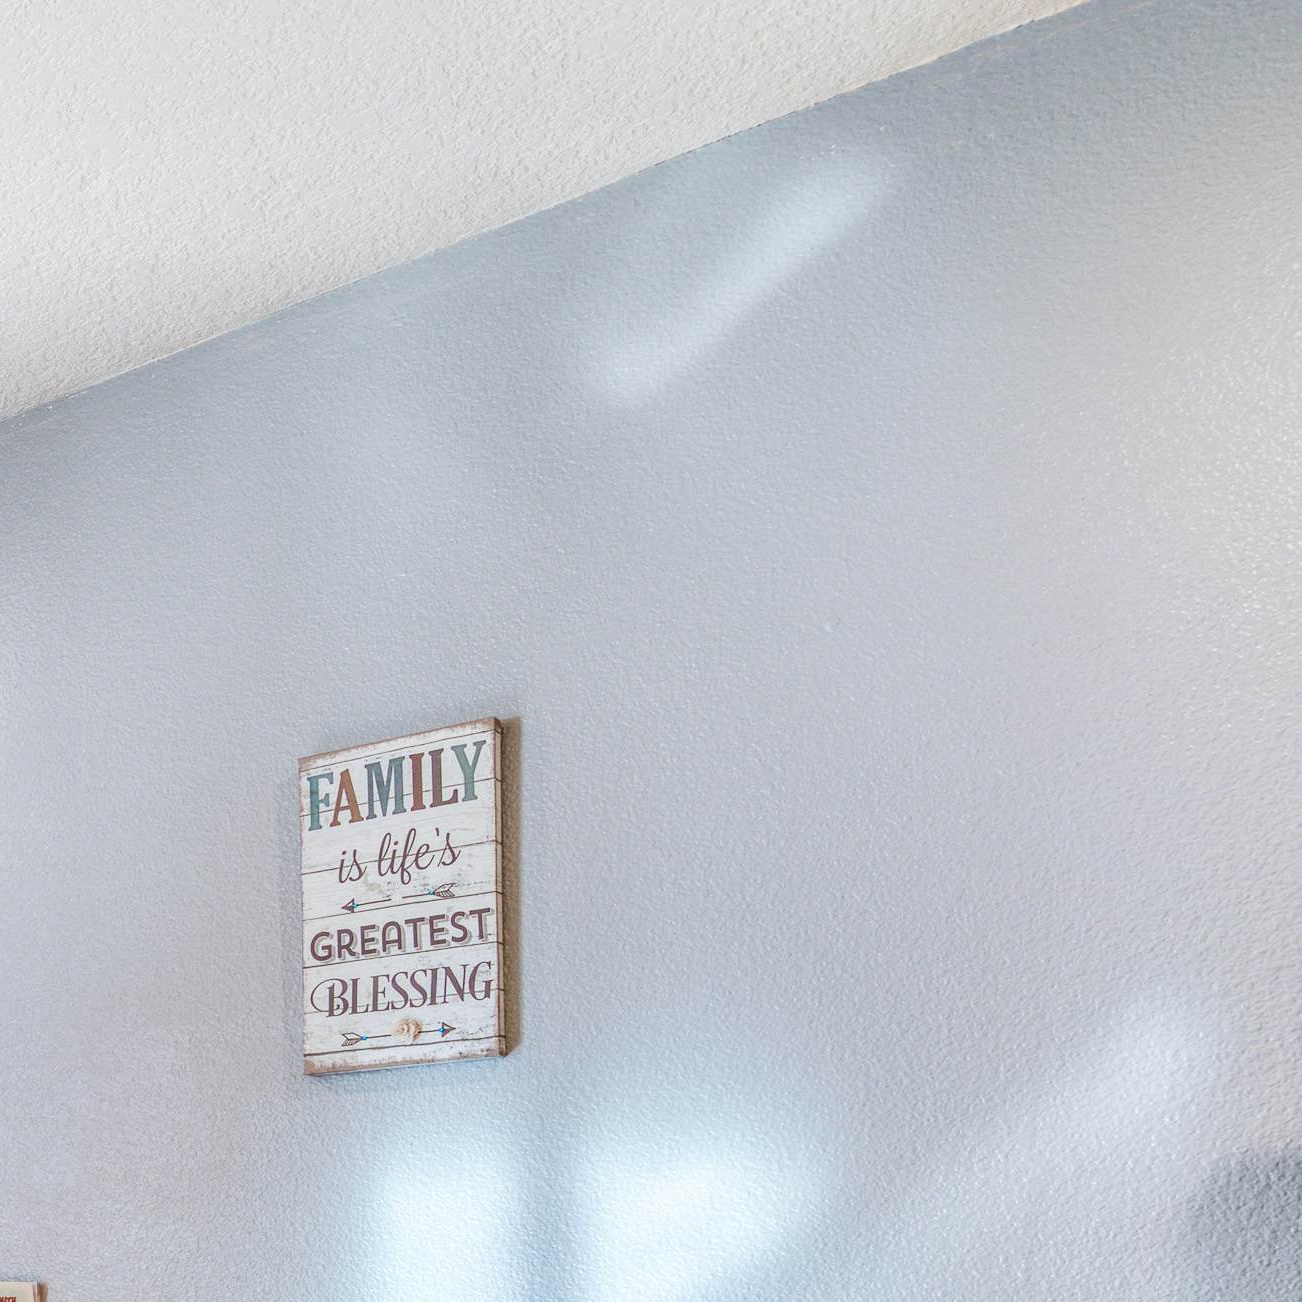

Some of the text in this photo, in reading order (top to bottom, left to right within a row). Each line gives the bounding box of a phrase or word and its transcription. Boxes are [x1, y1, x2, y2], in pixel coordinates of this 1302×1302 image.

[307, 739, 487, 832] FAMILY
[338, 827, 461, 885] is life's
[310, 907, 495, 963] GREATEST
[310, 960, 493, 1018] BLESSING
